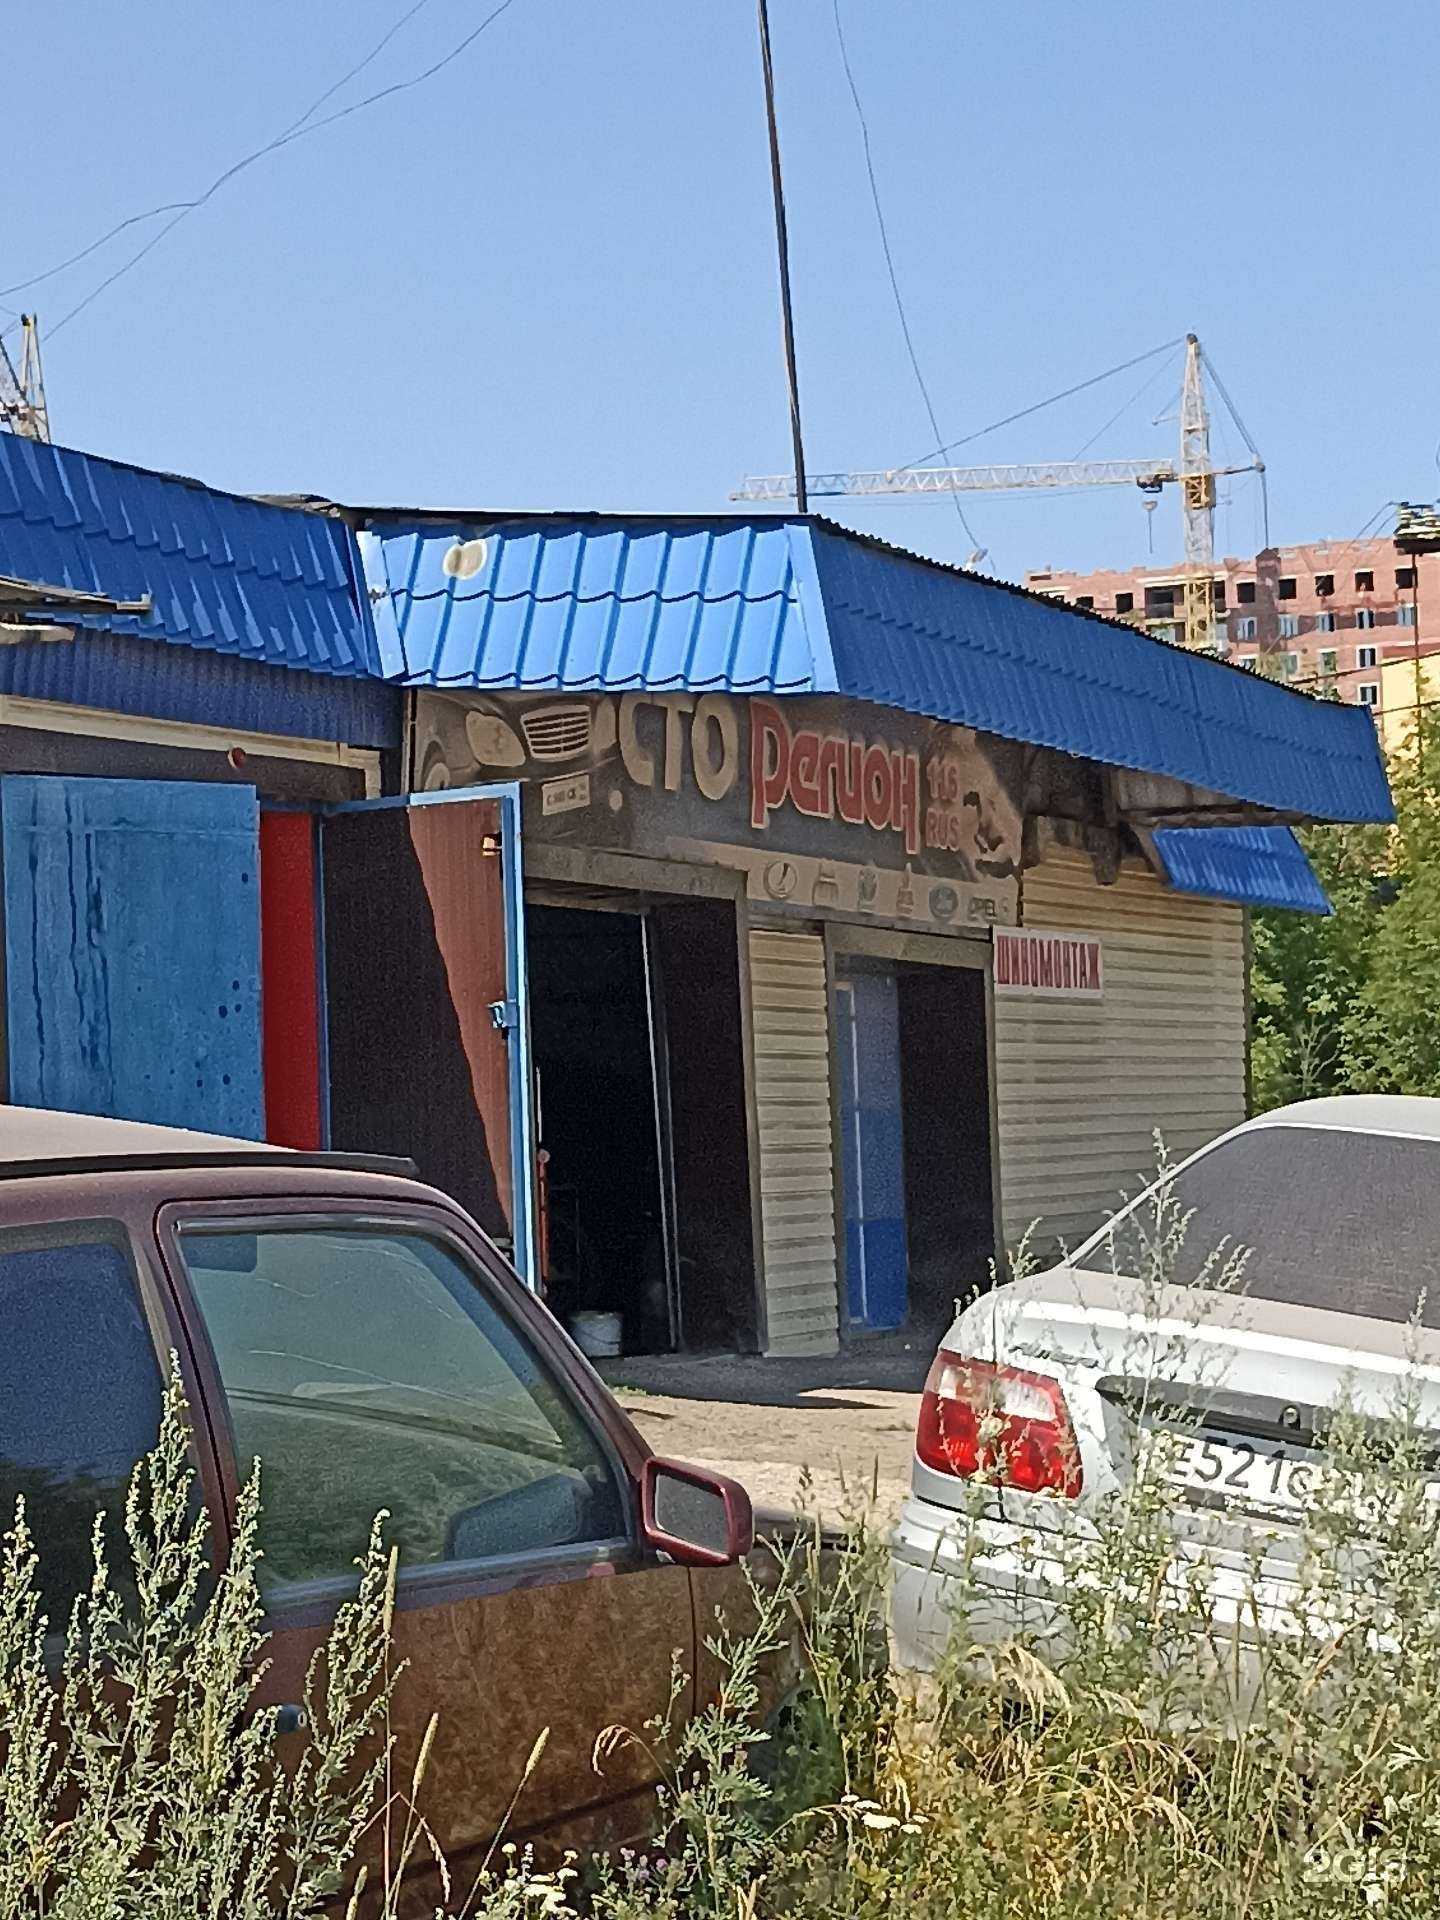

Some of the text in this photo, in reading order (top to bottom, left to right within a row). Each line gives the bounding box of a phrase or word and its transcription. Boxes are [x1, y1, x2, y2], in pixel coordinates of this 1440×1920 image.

[619, 693, 920, 854] СТО Регион
[925, 810, 962, 852] RUS
[996, 935, 1101, 988] ШИНОМОНТАЖ
[1167, 1436, 1320, 1499] Е521С
